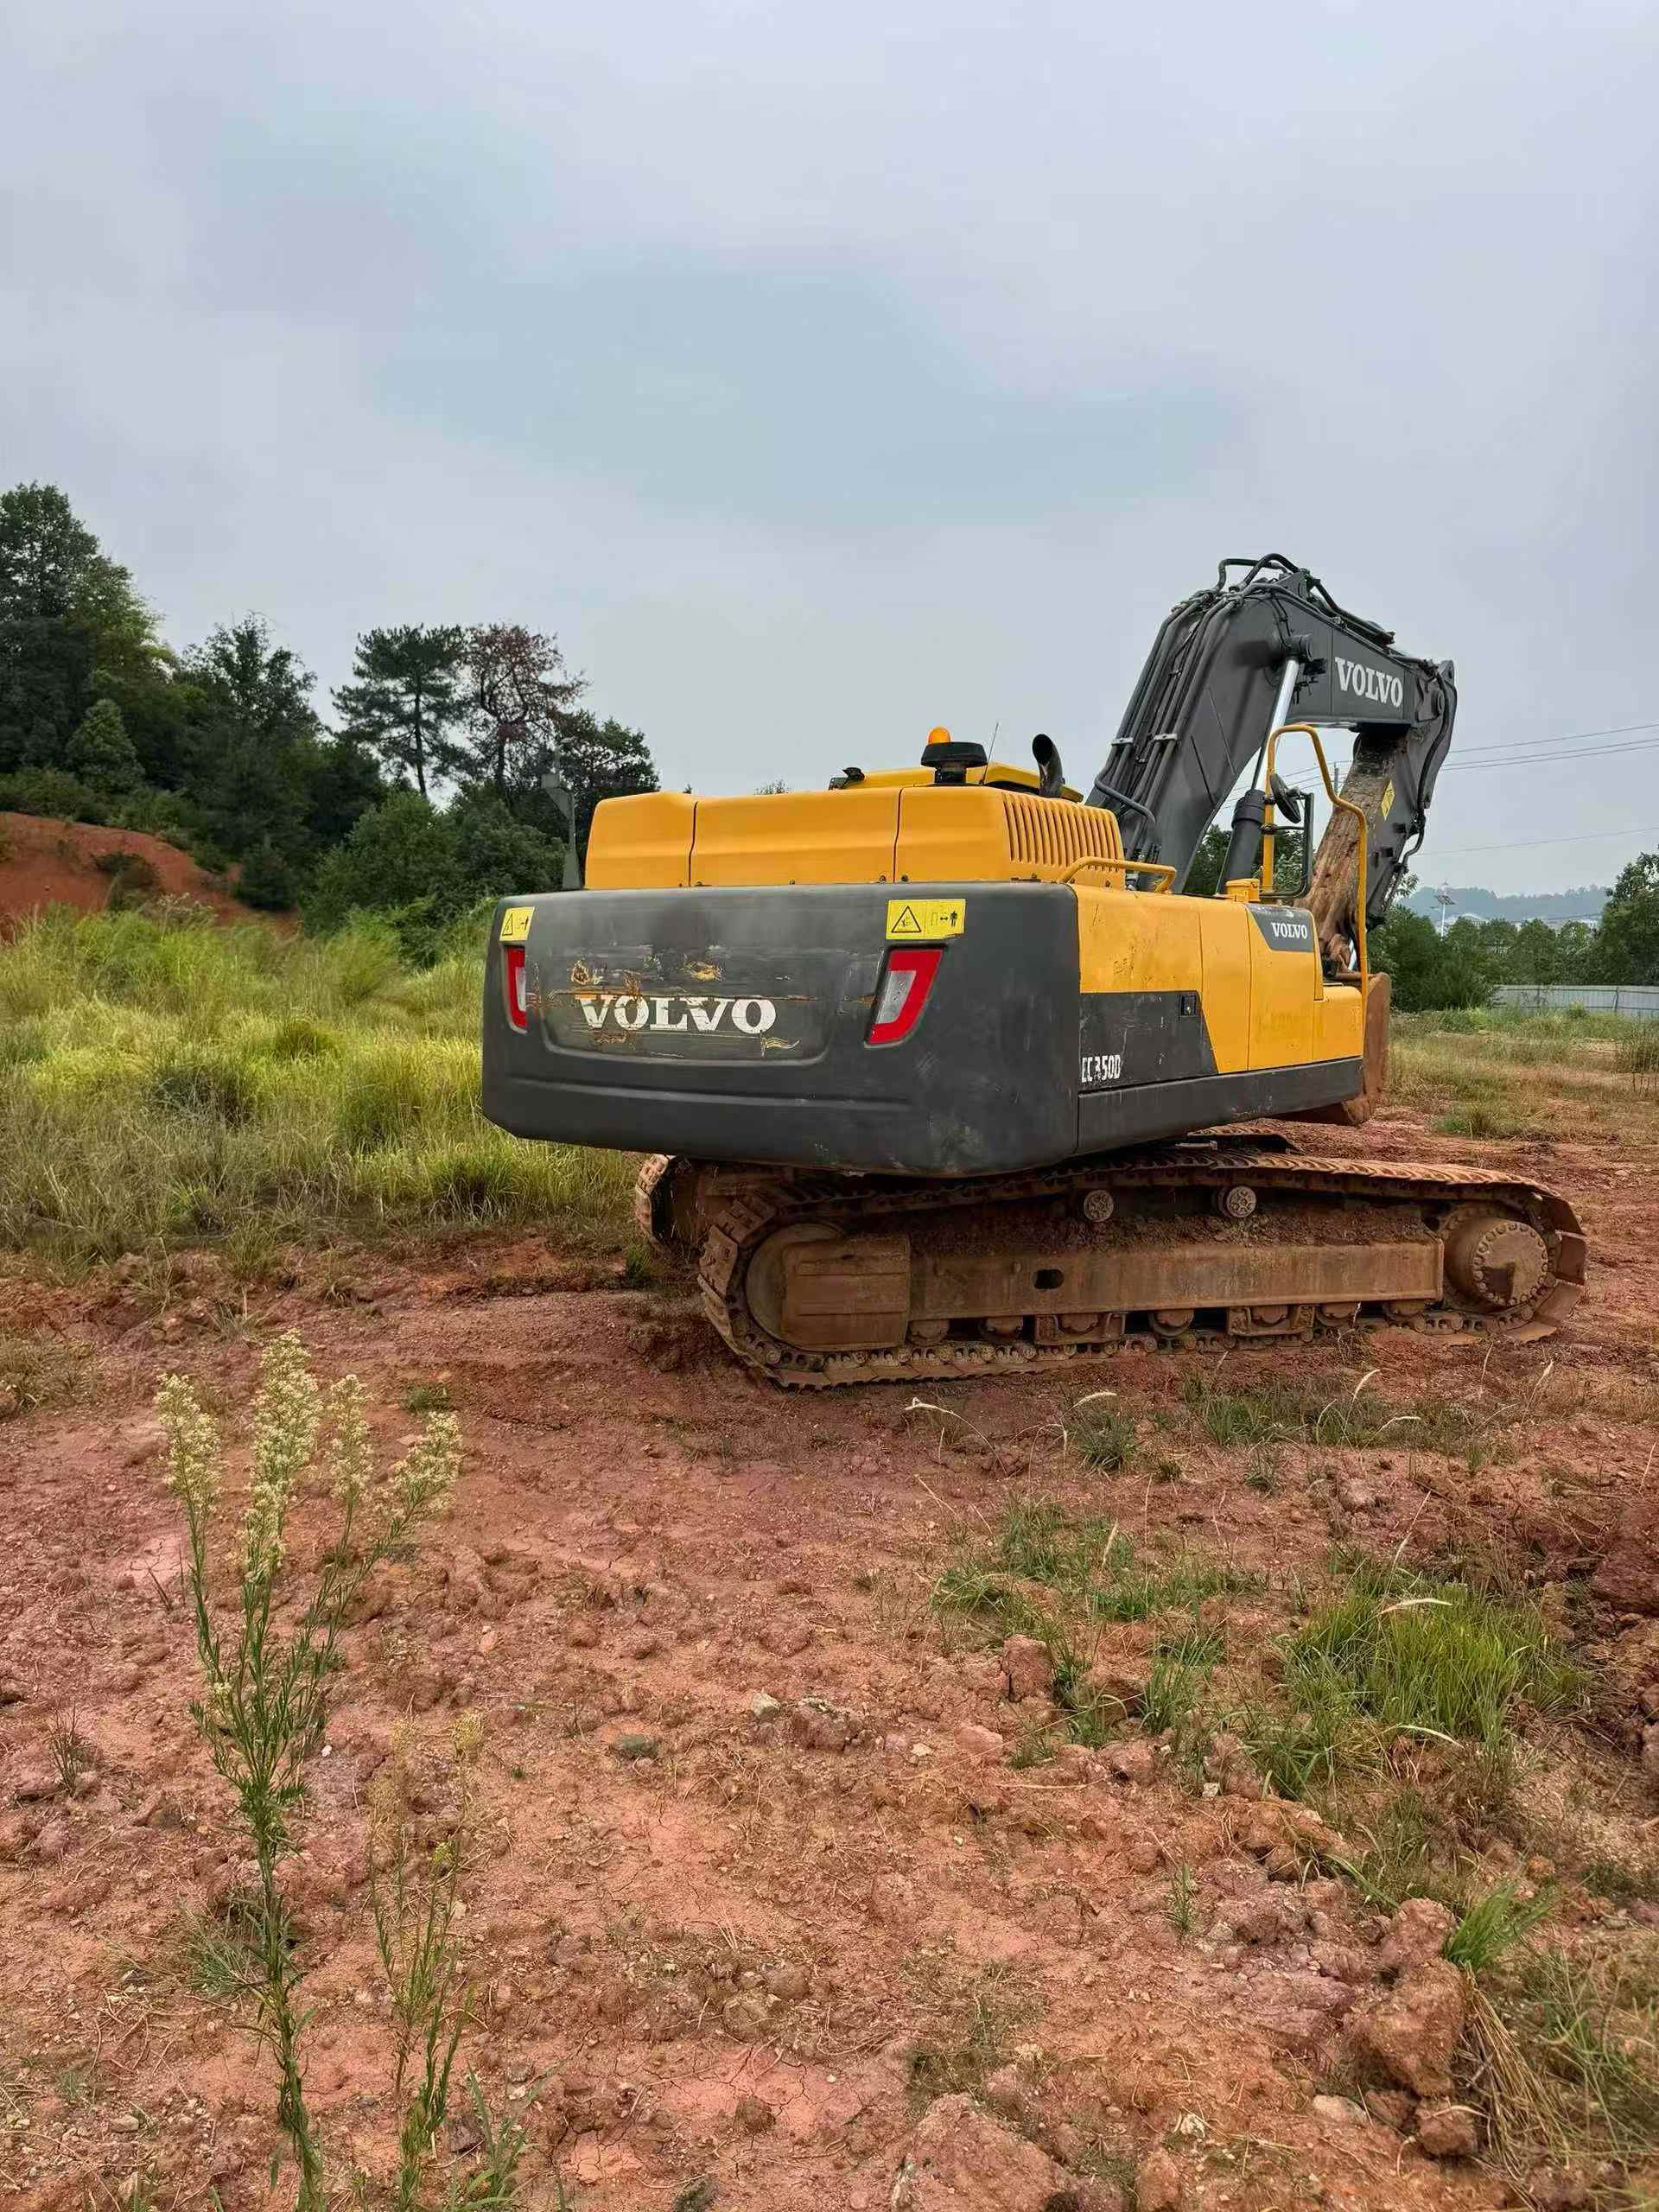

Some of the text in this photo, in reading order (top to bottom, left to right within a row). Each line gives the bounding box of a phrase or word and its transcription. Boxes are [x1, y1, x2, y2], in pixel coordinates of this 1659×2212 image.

[1335, 657, 1403, 708] VOLVO
[1271, 922, 1308, 939] VOLVO
[575, 995, 776, 1033] VOLVO
